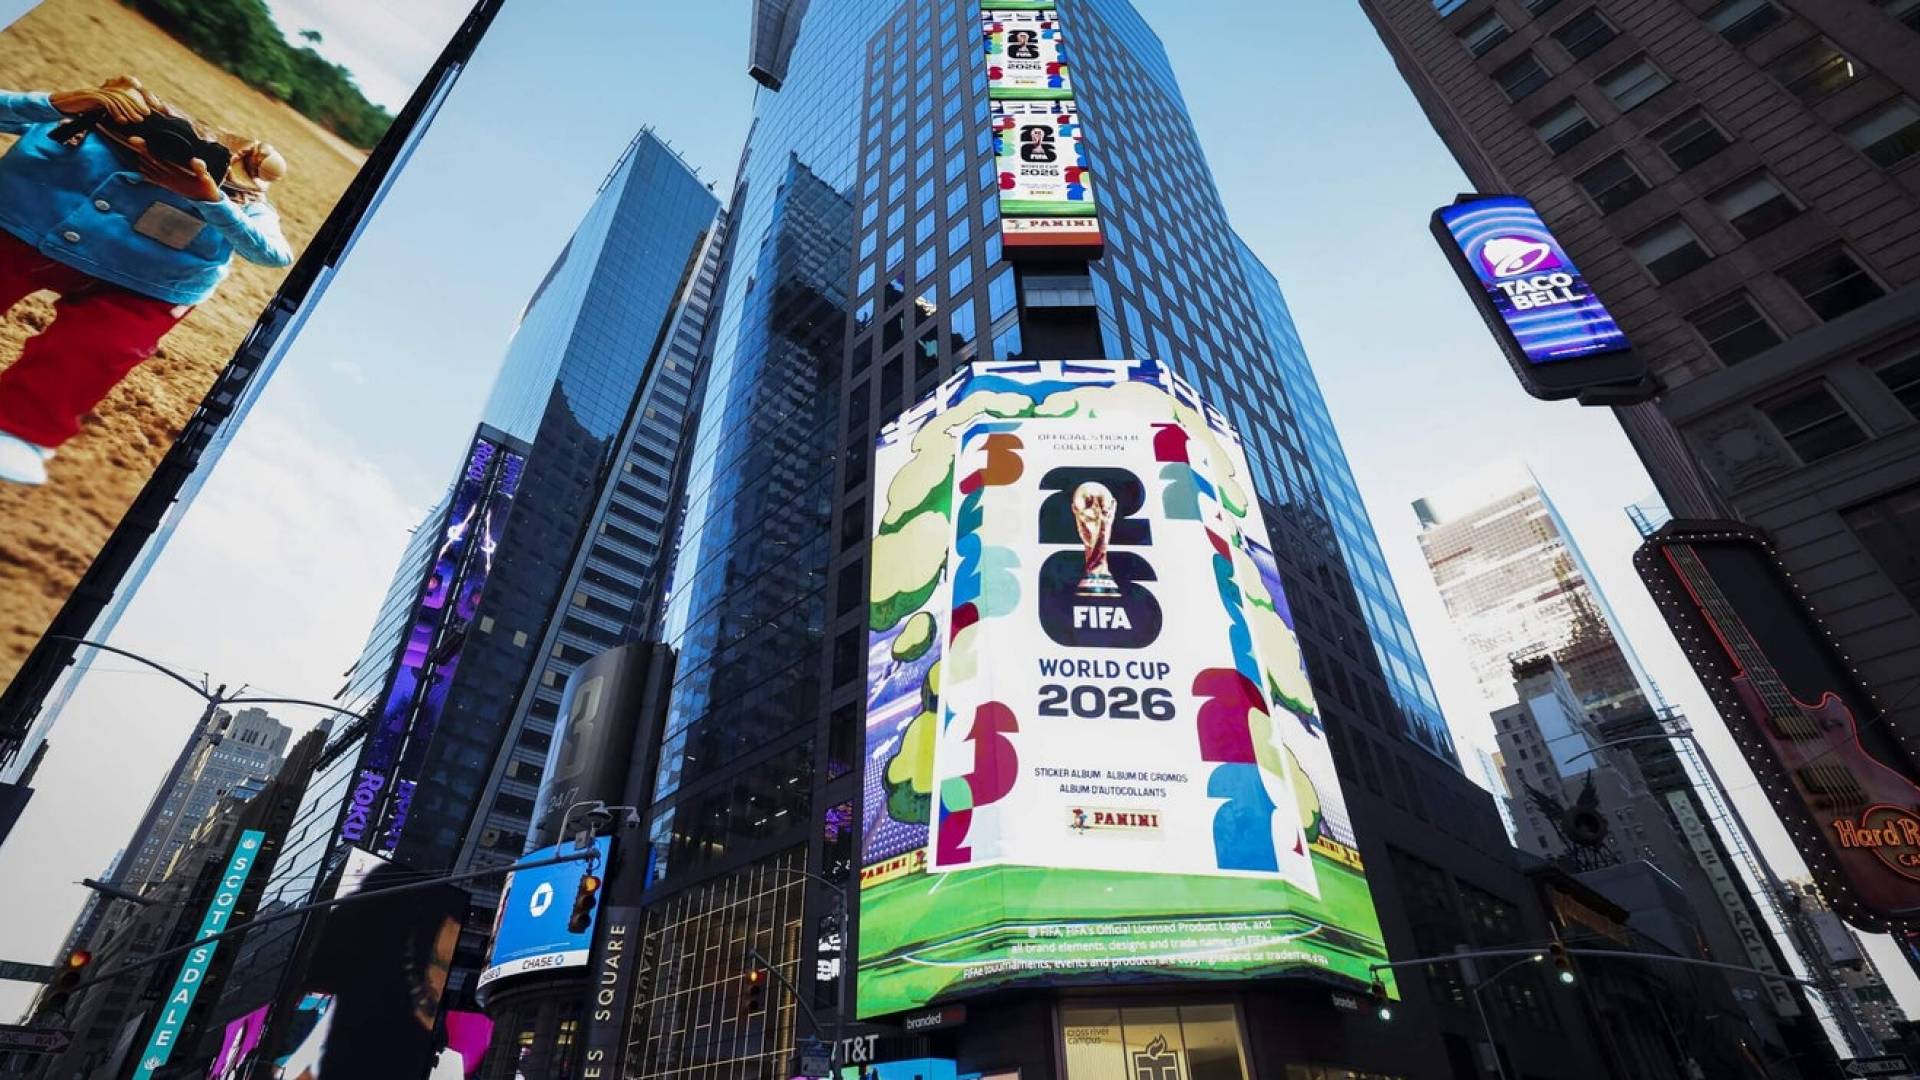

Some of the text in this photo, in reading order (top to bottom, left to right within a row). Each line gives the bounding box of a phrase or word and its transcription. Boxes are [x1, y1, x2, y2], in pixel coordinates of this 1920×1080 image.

[1497, 273, 1573, 296] TACO
[1512, 287, 1586, 310] BELL
[1073, 605, 1133, 630] FIFA
[1039, 658, 1170, 680] WORLD CUP
[1038, 684, 1176, 721] 2026
[1034, 767, 1188, 783] STICKER ALBUM ALBUM DE CROMOS
[1059, 784, 1167, 798] ALBUM D'AUTOCOLLANTS
[340, 771, 385, 842] ROKU
[1094, 812, 1159, 827] PANINI
[1832, 817, 1901, 848] Hard
[860, 857, 906, 880] PANINI
[1040, 927, 1063, 937] FIFA,
[1097, 925, 1131, 935] Official
[1134, 923, 1176, 934] Licensed
[1179, 922, 1217, 932] Product
[1253, 919, 1271, 930] and
[155, 856, 247, 1046] SCOTTSDALE
[1011, 942, 1023, 953] all
[1025, 942, 1055, 953] brand
[1109, 940, 1148, 952] designs
[1150, 939, 1168, 949] and
[522, 956, 553, 970] CHASE
[595, 924, 626, 1021] SQUARE
[1089, 958, 1109, 968] and
[907, 1012, 942, 1030] branded
